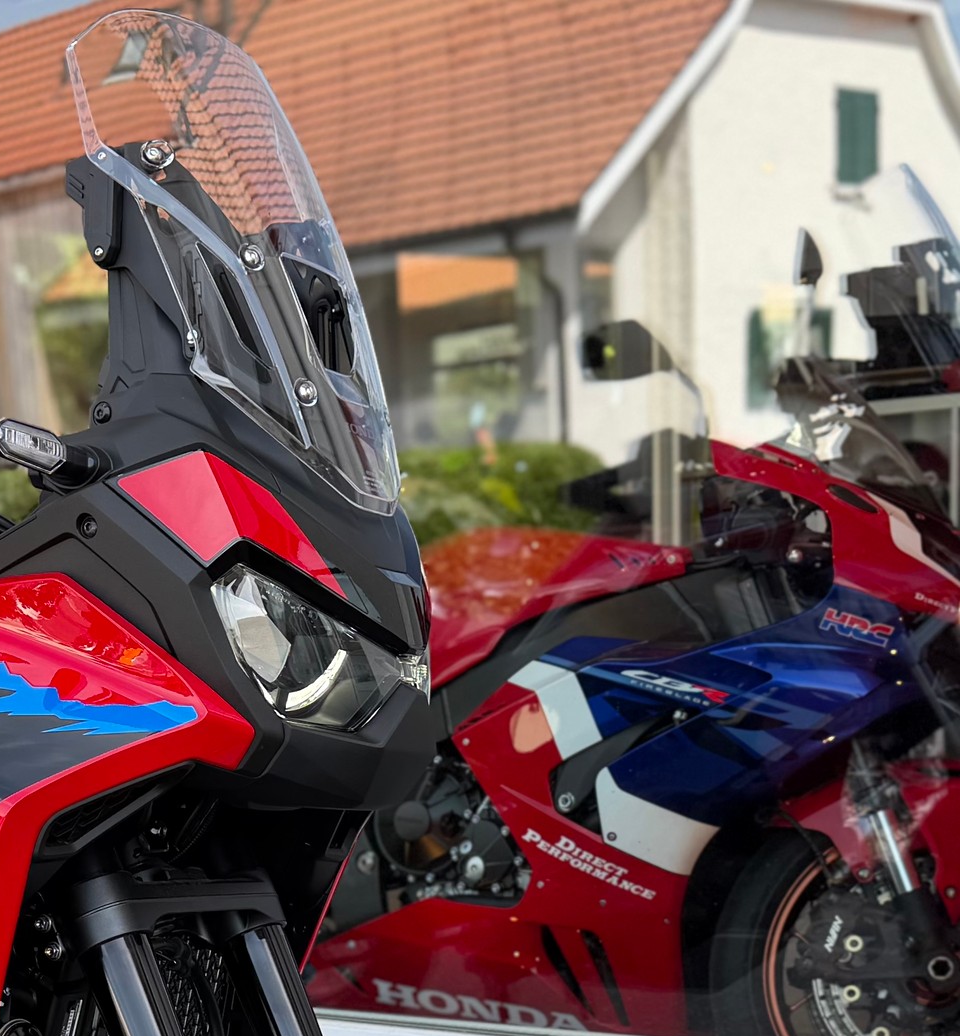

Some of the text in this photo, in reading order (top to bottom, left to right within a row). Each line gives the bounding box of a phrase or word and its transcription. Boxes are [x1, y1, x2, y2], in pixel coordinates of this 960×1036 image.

[819, 608, 894, 648] HRC
[630, 679, 710, 706] FIREBLADE
[521, 827, 657, 900] PERFORMANCE
[371, 977, 591, 1032] HONDA
